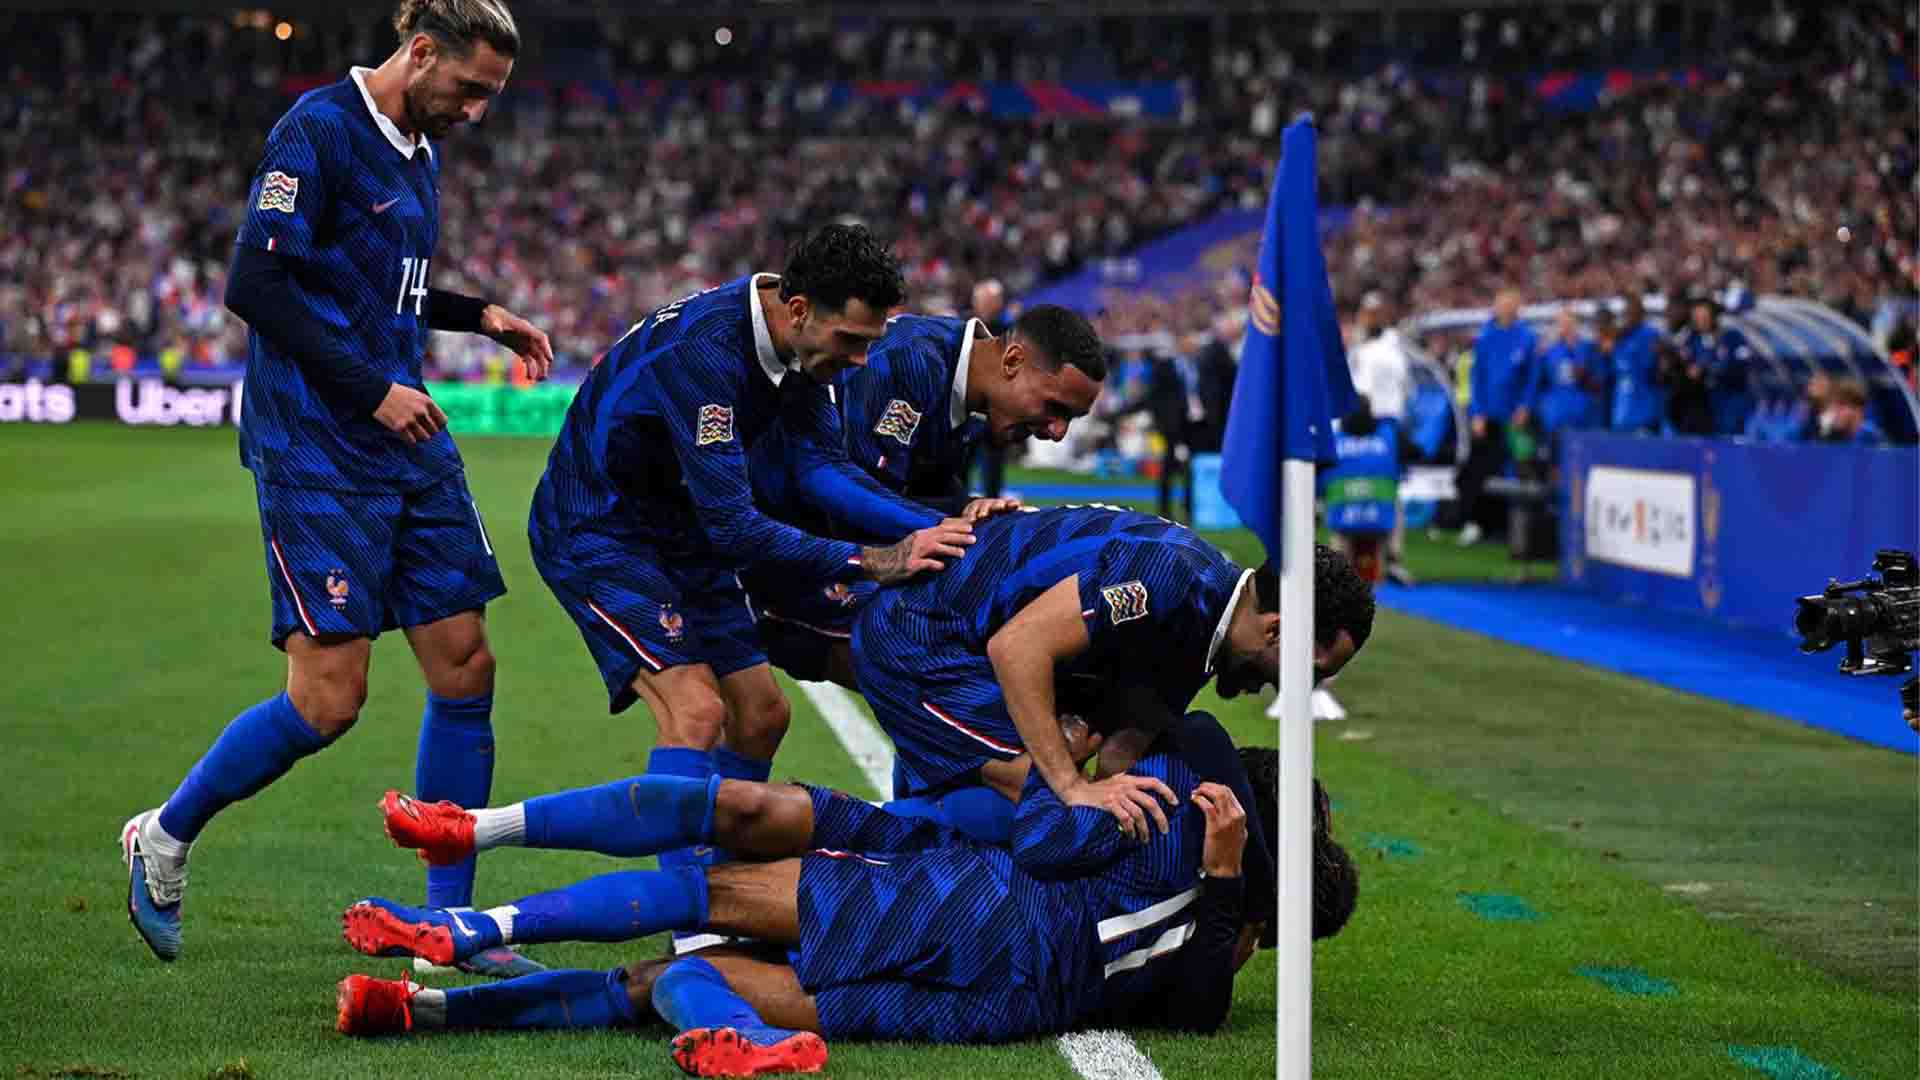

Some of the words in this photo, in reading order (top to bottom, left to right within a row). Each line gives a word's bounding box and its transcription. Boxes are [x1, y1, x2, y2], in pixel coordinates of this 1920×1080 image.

[397, 257, 429, 315] 14
[0, 377, 75, 422] ats
[116, 377, 226, 426] Uber
[1097, 888, 1197, 981] 11
